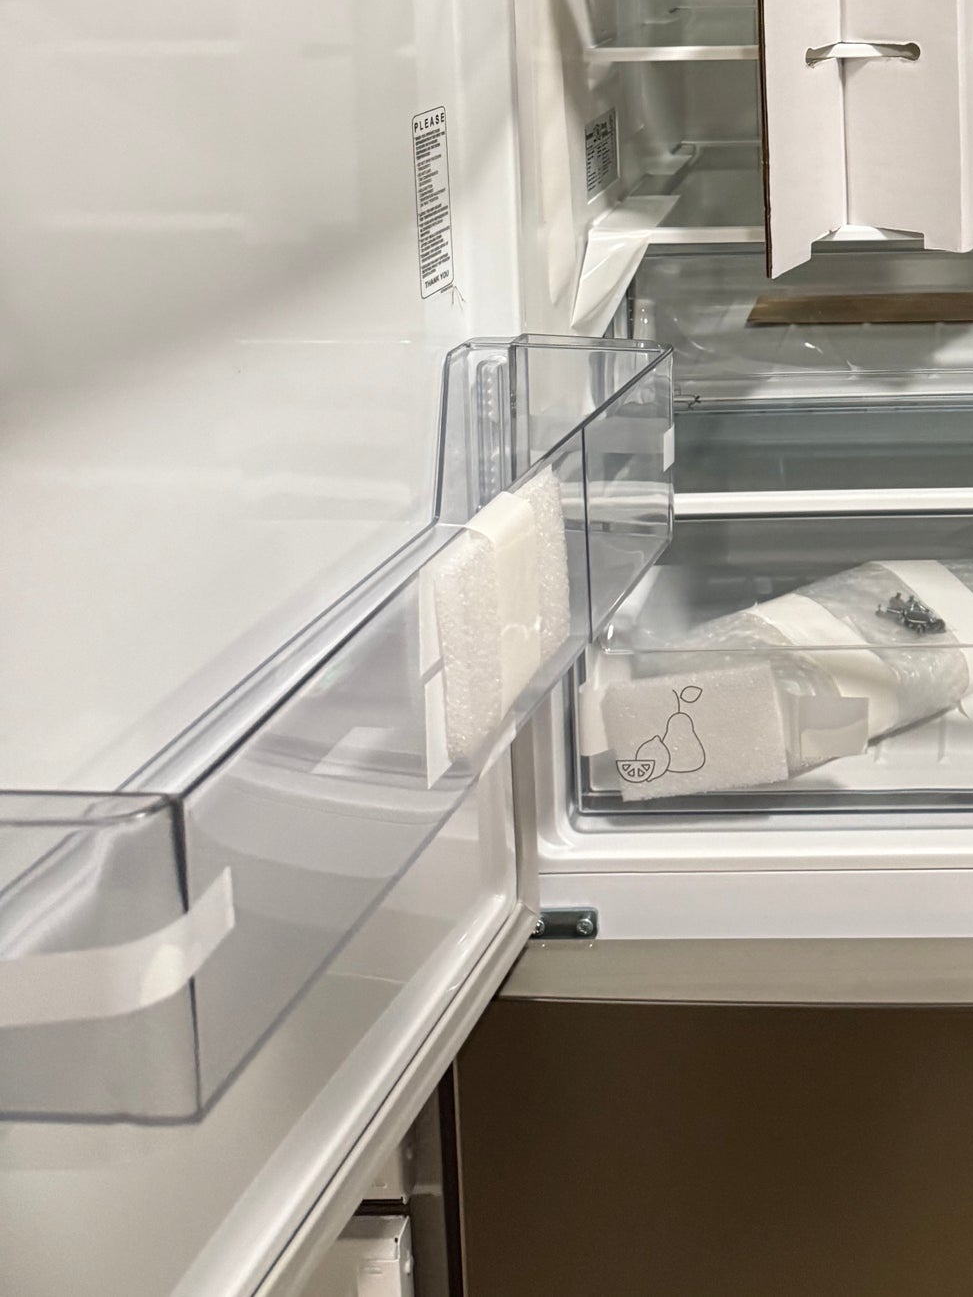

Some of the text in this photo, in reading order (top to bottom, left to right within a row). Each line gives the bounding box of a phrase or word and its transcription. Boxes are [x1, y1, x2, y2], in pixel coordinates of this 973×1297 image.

[414, 112, 445, 133] PLEASE
[424, 274, 440, 289] THANK
[440, 269, 450, 280] YOU
